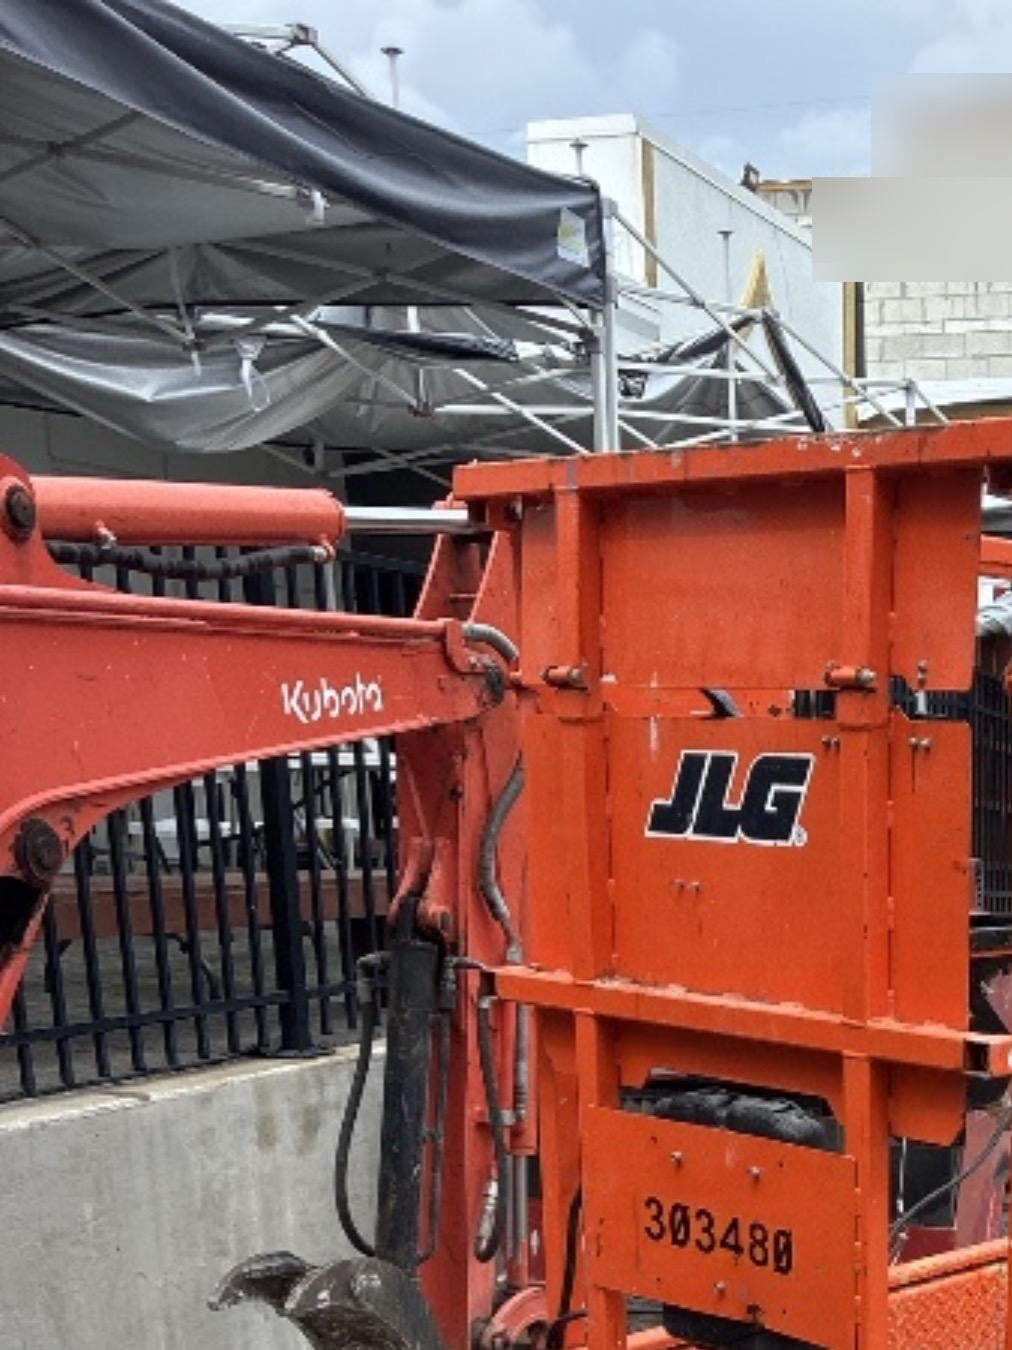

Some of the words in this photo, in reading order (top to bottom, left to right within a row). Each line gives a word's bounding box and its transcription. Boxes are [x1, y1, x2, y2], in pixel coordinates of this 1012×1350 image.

[281, 671, 383, 724] Kubota
[645, 749, 815, 847] JLG
[644, 1196, 793, 1275] 303480
